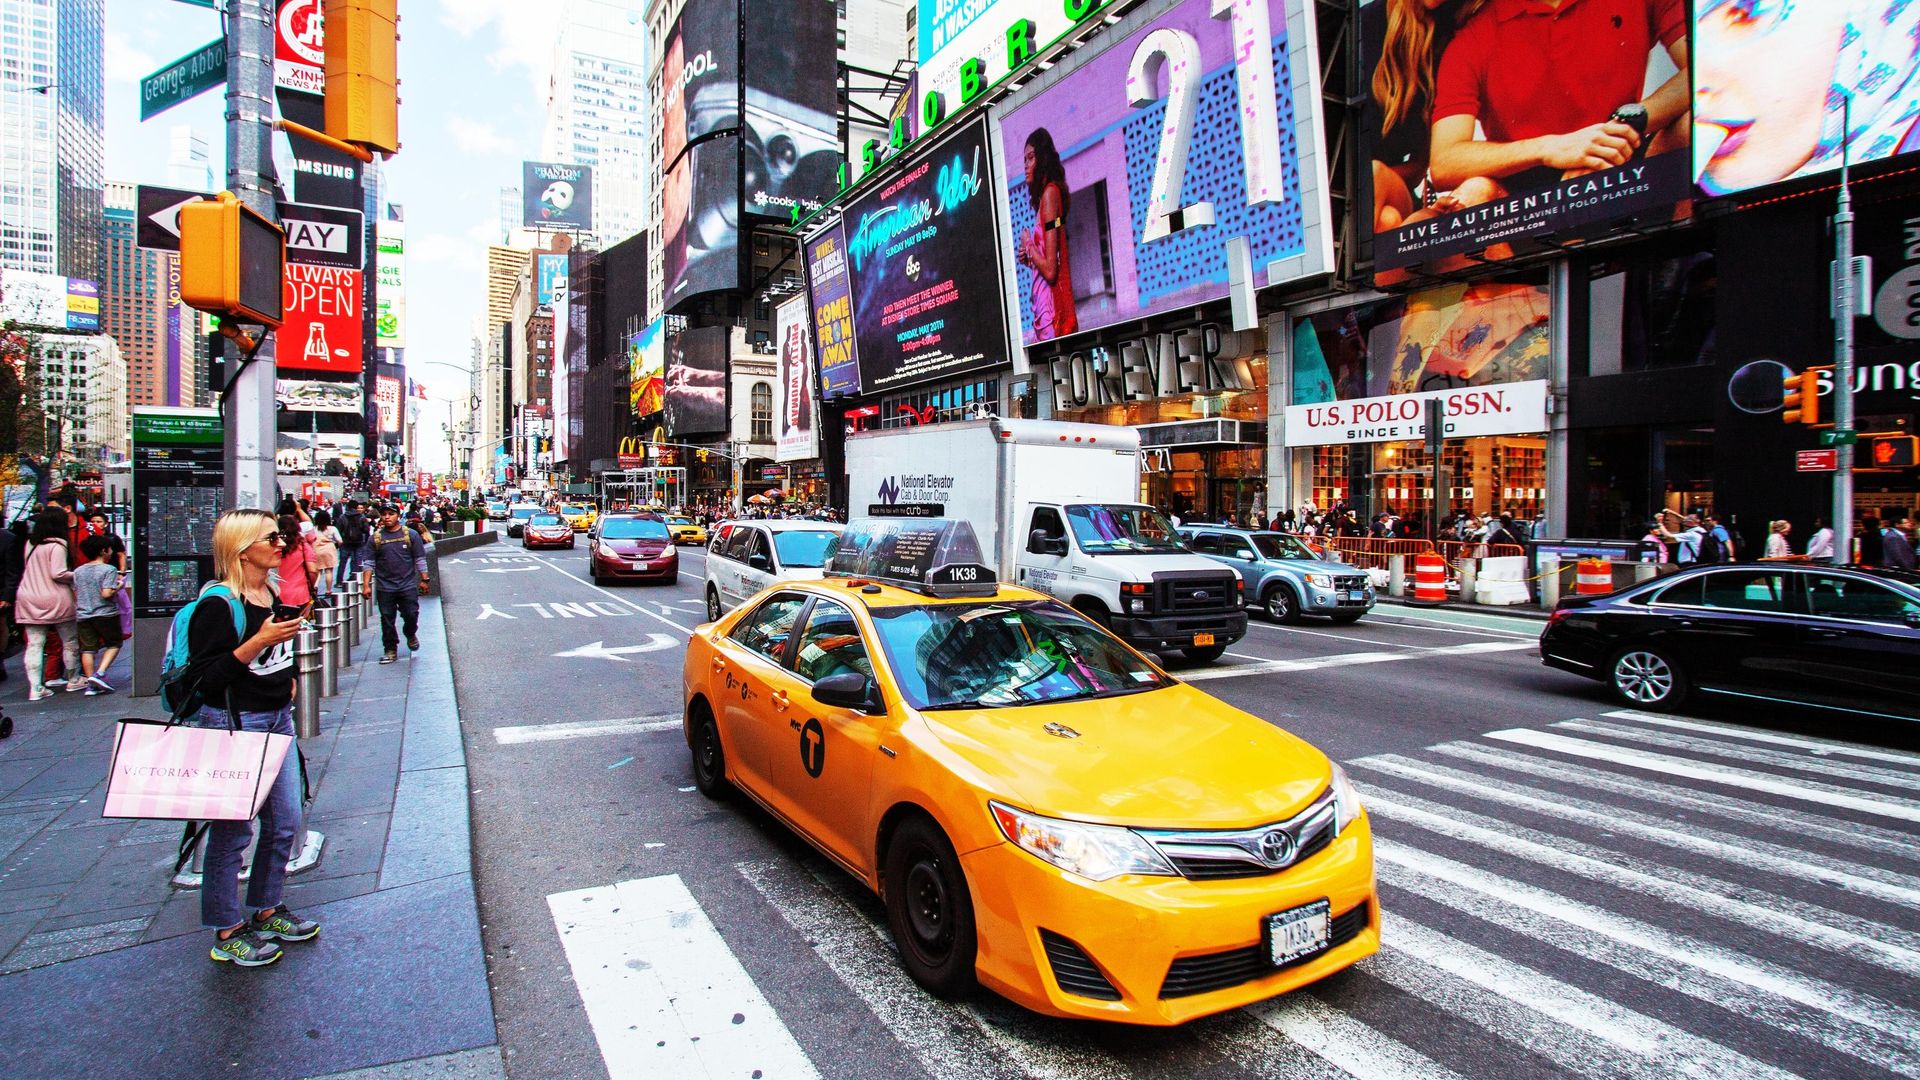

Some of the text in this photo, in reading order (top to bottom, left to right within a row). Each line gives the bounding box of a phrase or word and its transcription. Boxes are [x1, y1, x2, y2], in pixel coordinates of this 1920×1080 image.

[145, 66, 185, 101] George
[278, 76, 310, 90] NEWS
[681, 50, 718, 91] COOL
[848, 145, 982, 272] American Idol
[1399, 166, 1645, 243] LIVE AUTHENTICALLY
[1397, 241, 1428, 254] PAMELA
[1430, 228, 1476, 245] FLANAGAN
[1488, 217, 1520, 231] JONNY
[1523, 206, 1558, 221] LAVINE
[1569, 197, 1598, 210] POLO
[1602, 184, 1650, 201] PLAYERS
[816, 296, 850, 327] COME
[821, 338, 853, 369] AWAY
[1049, 322, 1230, 412] FOREVER
[1306, 406, 1346, 427] U.S.
[1352, 399, 1420, 424] POLO
[1347, 426, 1399, 439] SINCE
[1826, 433, 1837, 443] 7
[1155, 448, 1172, 472] 21
[901, 474, 954, 489] National Elevator
[901, 489, 951, 504] Cab & Door Corp.
[906, 505, 921, 516] curb
[949, 567, 977, 581] 1K38
[790, 718, 802, 732] NYC
[806, 728, 820, 770] T
[123, 765, 250, 780] VICTORIA'S SECRET
